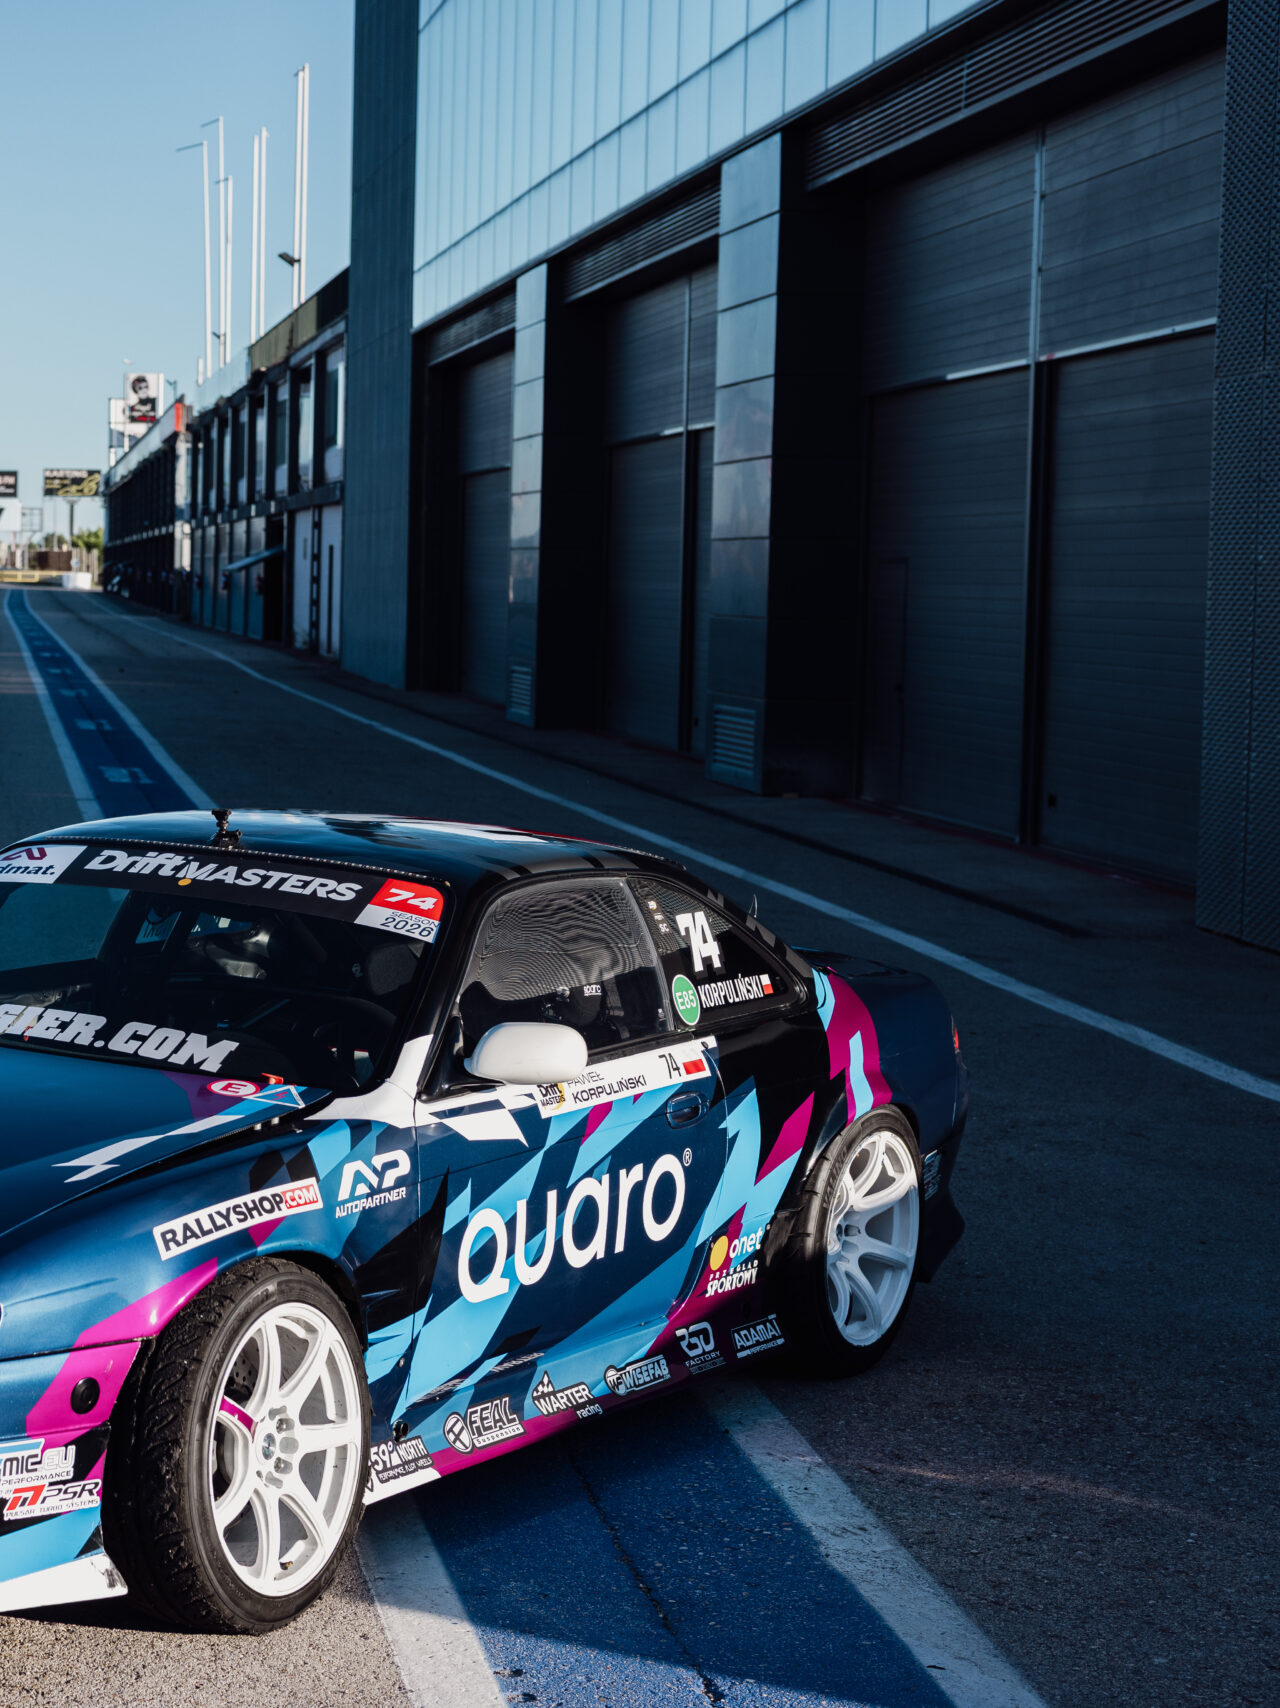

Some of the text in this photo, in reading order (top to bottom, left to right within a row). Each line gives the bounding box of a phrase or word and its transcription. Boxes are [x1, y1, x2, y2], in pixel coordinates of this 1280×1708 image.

[384, 888, 438, 910] 74
[380, 917, 434, 938] 2026
[390, 911, 440, 928] SEASON
[675, 911, 722, 973] 74
[583, 984, 602, 996] sparc
[675, 990, 697, 1010] E85
[698, 973, 764, 1009] KORPULIŃSKI
[658, 1053, 682, 1080] 74
[572, 1075, 647, 1104] KORPULIŃSKI
[335, 1187, 407, 1219] AUTOPARTNER
[160, 1184, 319, 1253] RALLYSHOP.COM
[729, 1227, 763, 1259] onet
[705, 1267, 759, 1298] SPORTOWY
[685, 1350, 721, 1368] FACTORY
[622, 1358, 670, 1390] WISEFAB
[535, 1385, 594, 1415] WARTER
[576, 1403, 603, 1420] racing
[467, 1397, 520, 1438] FEAL
[476, 1426, 521, 1445] Suspension
[1, 1470, 72, 1487] PERFORMANCE
[40, 1482, 100, 1505] PSR
[5, 1509, 36, 1519] PULSAR
[65, 1499, 99, 1510] SYSTEMS
